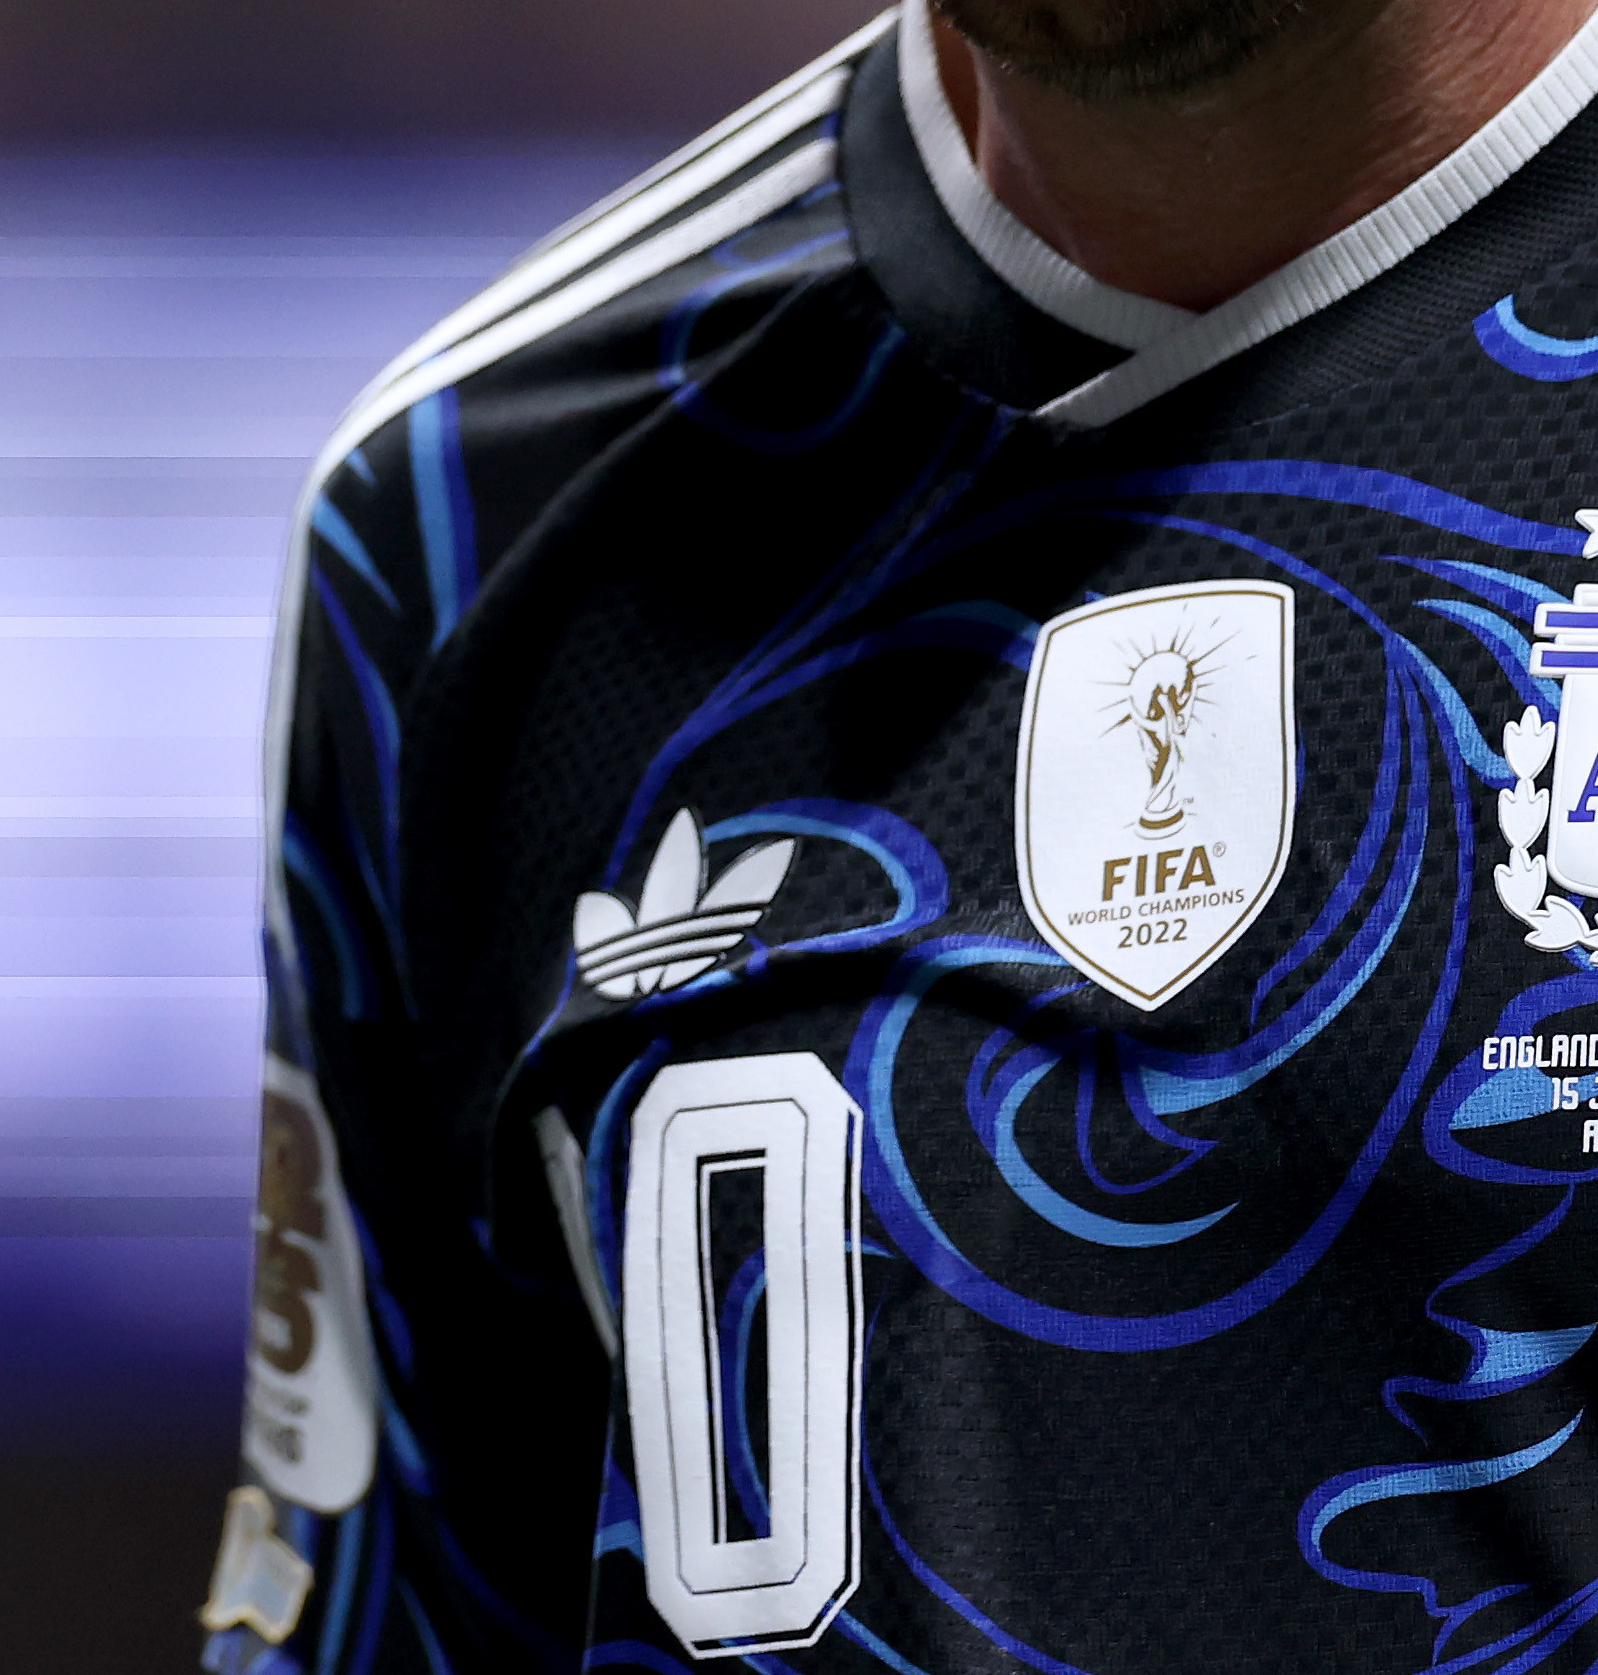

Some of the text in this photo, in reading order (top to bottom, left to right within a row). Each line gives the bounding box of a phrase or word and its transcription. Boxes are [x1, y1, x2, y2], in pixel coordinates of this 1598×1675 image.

[1068, 888, 1245, 926] WORLD CHAMPIONS
[1117, 917, 1188, 949] 2022
[1551, 1076, 1579, 1111] 15
